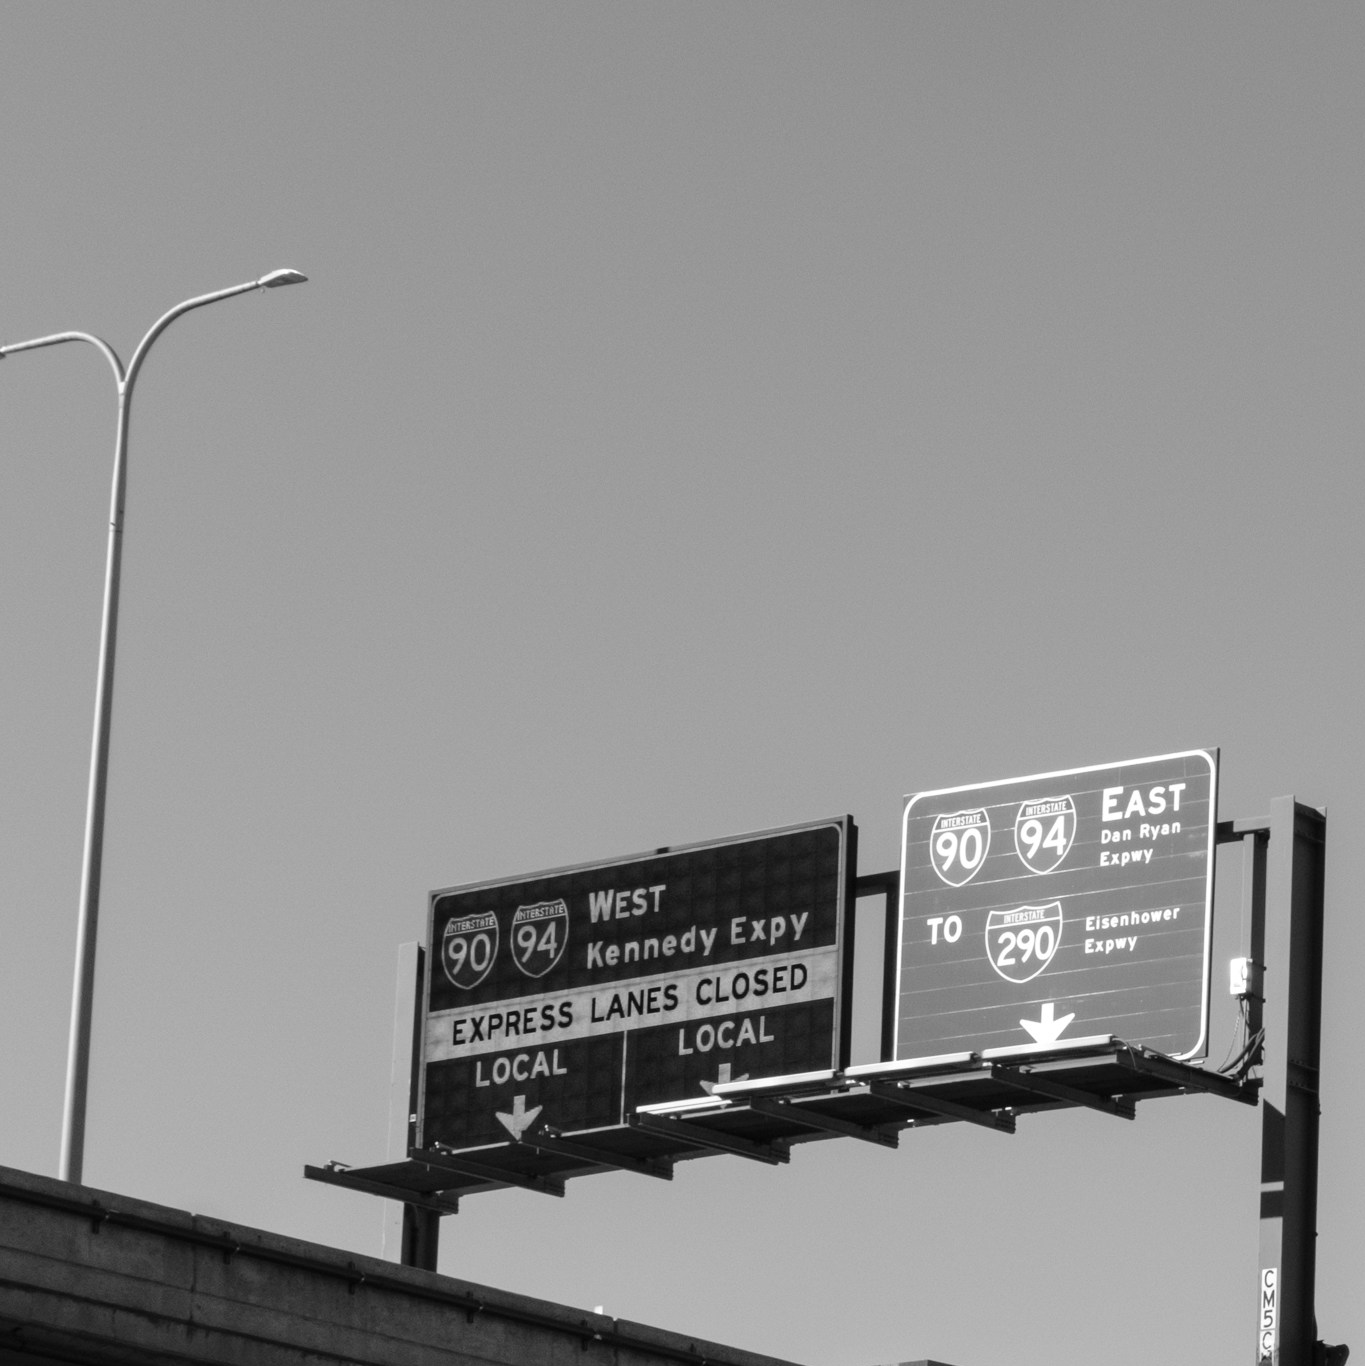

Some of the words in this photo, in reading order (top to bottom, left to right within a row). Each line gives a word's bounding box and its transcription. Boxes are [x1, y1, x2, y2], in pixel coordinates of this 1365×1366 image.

[1025, 800, 1068, 816] INTERSTATE
[1101, 783, 1187, 822] EAST
[940, 813, 983, 829] INTERSTATE
[1100, 828, 1132, 846] Dan
[1139, 821, 1182, 842] Ryan
[935, 828, 983, 872] 90
[1020, 815, 1067, 859] 94
[1100, 846, 1154, 868] Expwy
[516, 903, 565, 921] INTERSTATE
[588, 884, 667, 923] WEST
[1003, 908, 1046, 924] INTERSTATE
[1085, 907, 1181, 932] Eisenhower
[447, 915, 495, 933] INTERSTATE
[586, 925, 718, 969] Kennedy
[730, 911, 809, 947] Expy
[448, 932, 491, 975] 90
[517, 920, 558, 964] 94
[926, 915, 963, 945] TO
[997, 926, 1055, 967] 290
[1084, 934, 1139, 955] Expwy
[452, 1001, 574, 1046] EXPRESS
[591, 984, 679, 1024] LANES
[695, 963, 808, 1005] CLOSED
[678, 1015, 775, 1056] LOCAL
[475, 1048, 568, 1088] LOCAL
